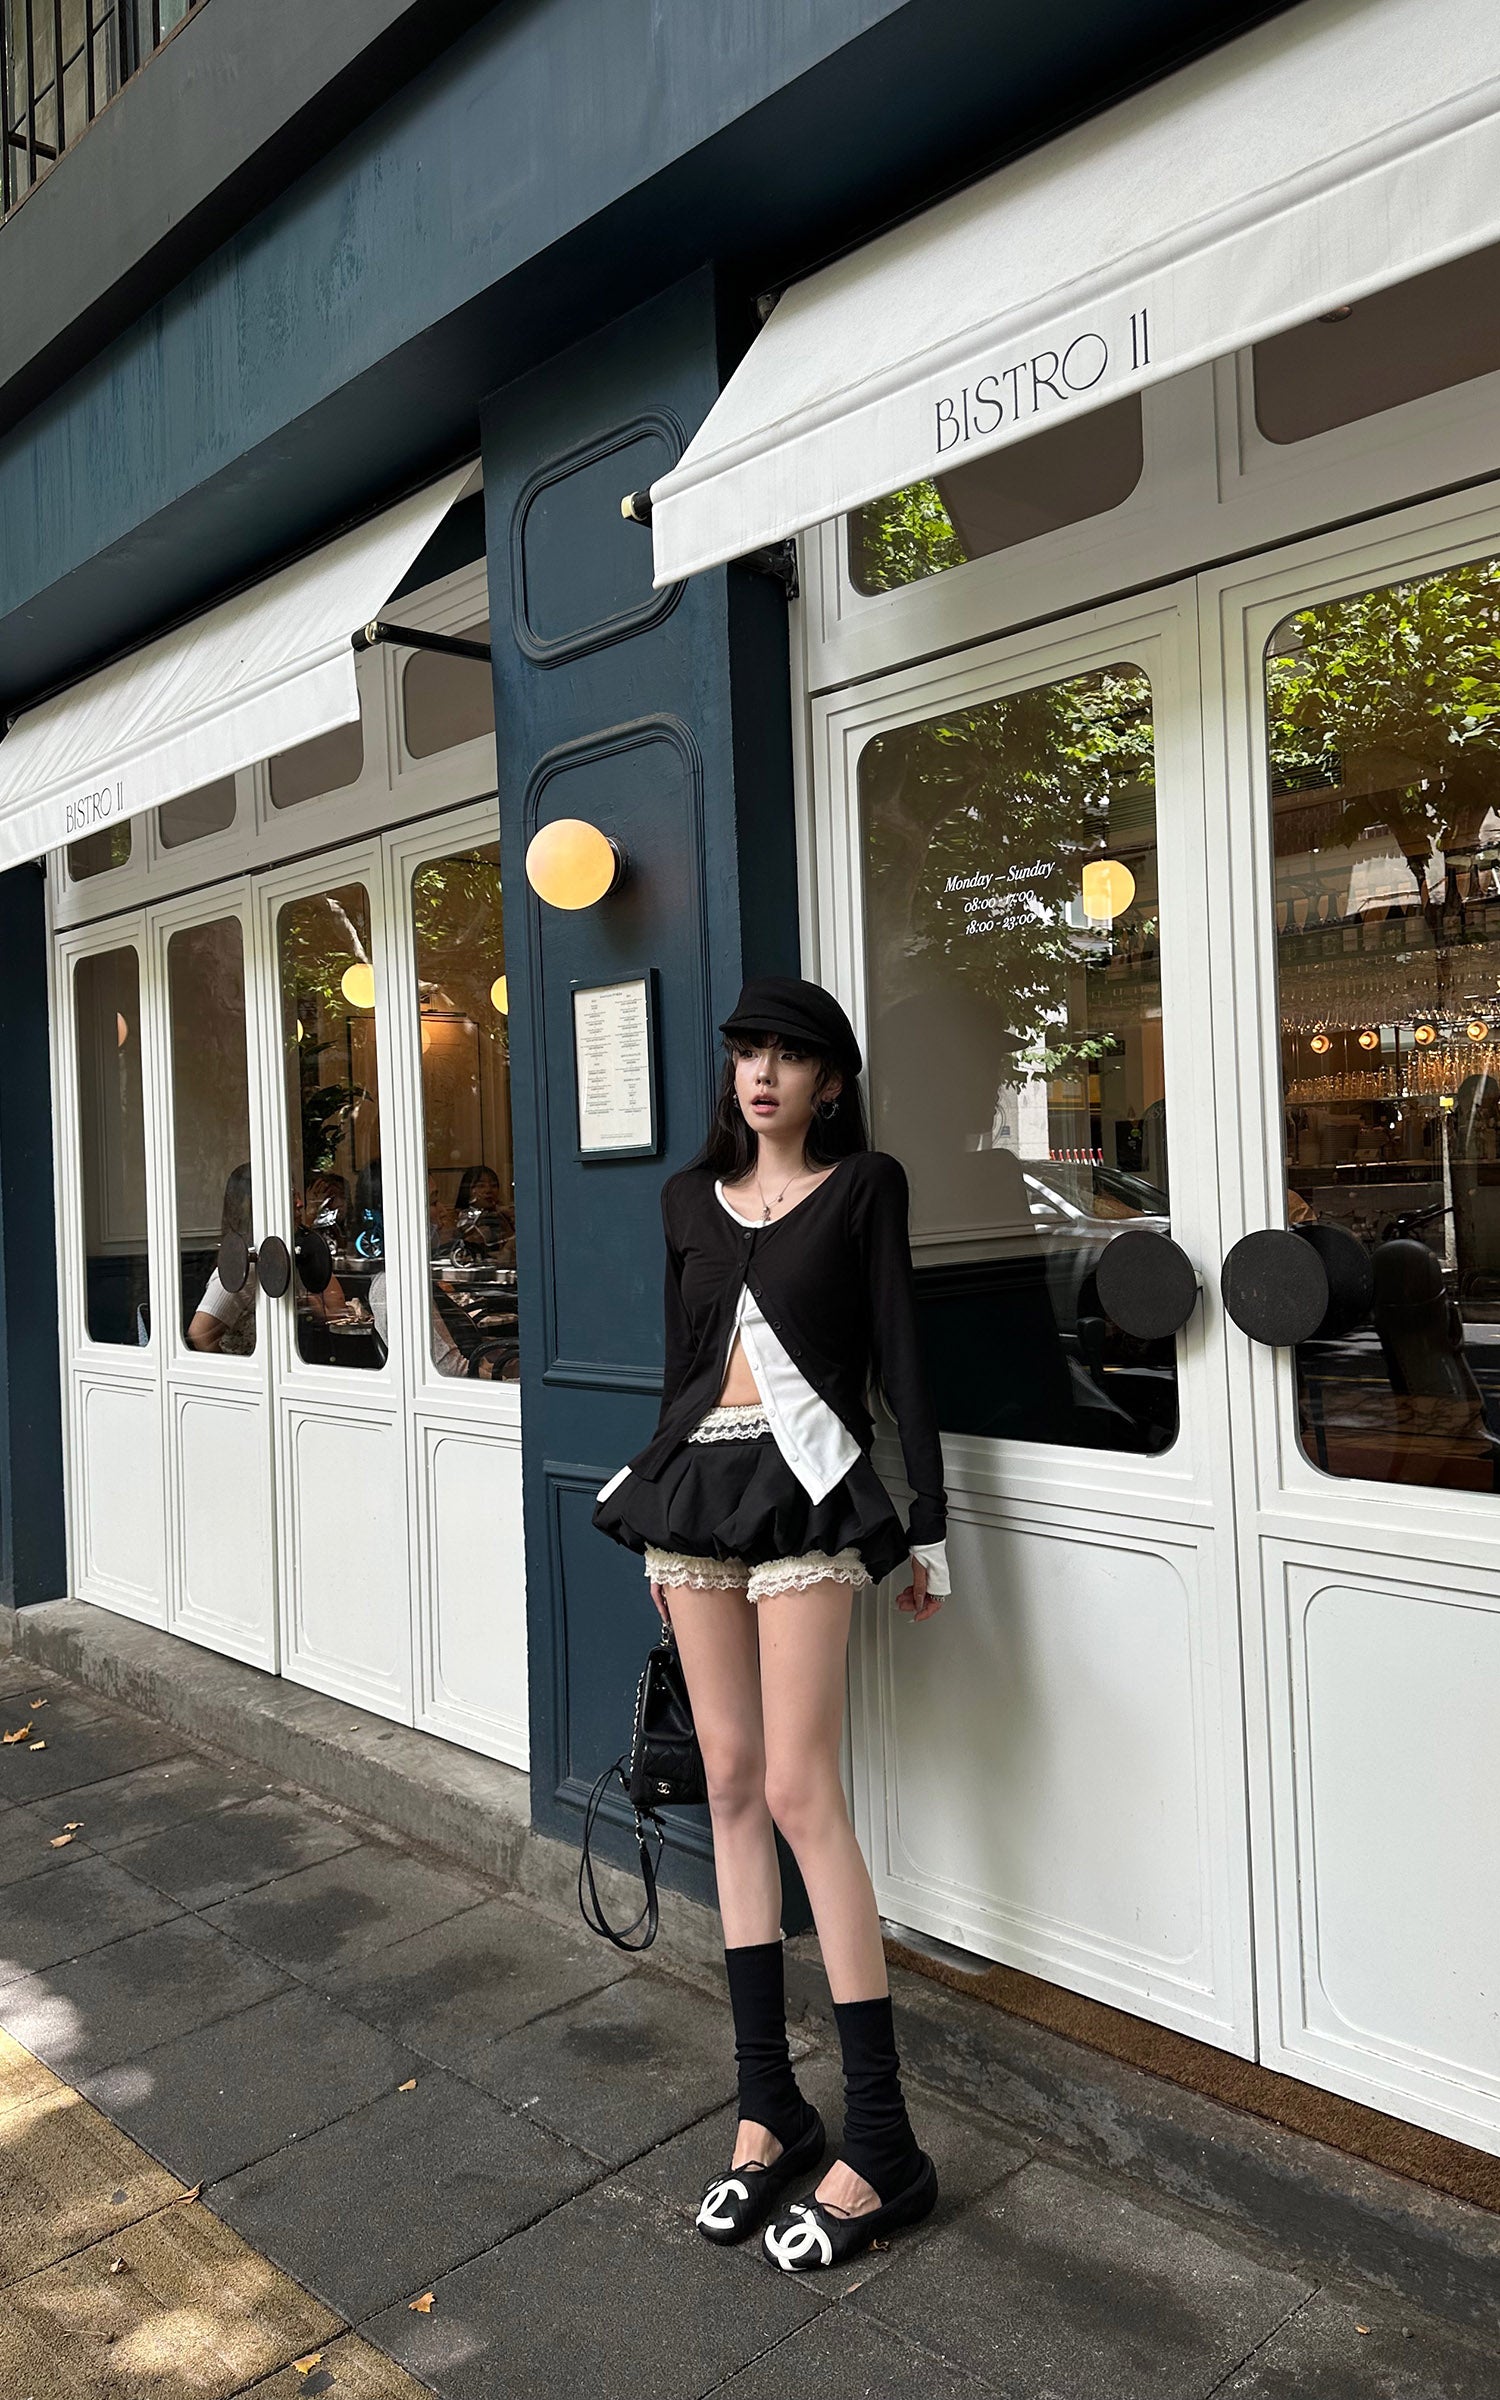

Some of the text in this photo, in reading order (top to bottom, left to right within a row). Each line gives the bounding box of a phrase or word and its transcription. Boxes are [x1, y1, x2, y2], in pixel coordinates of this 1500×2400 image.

[935, 332, 1108, 454] BISTRO
[66, 787, 112, 833] BISTRO
[943, 870, 994, 893] Monday
[1006, 859, 1055, 882] Sunday
[964, 896, 996, 913] 08:00
[965, 919, 994, 935] 18:00
[1002, 912, 1037, 931] 23:00
